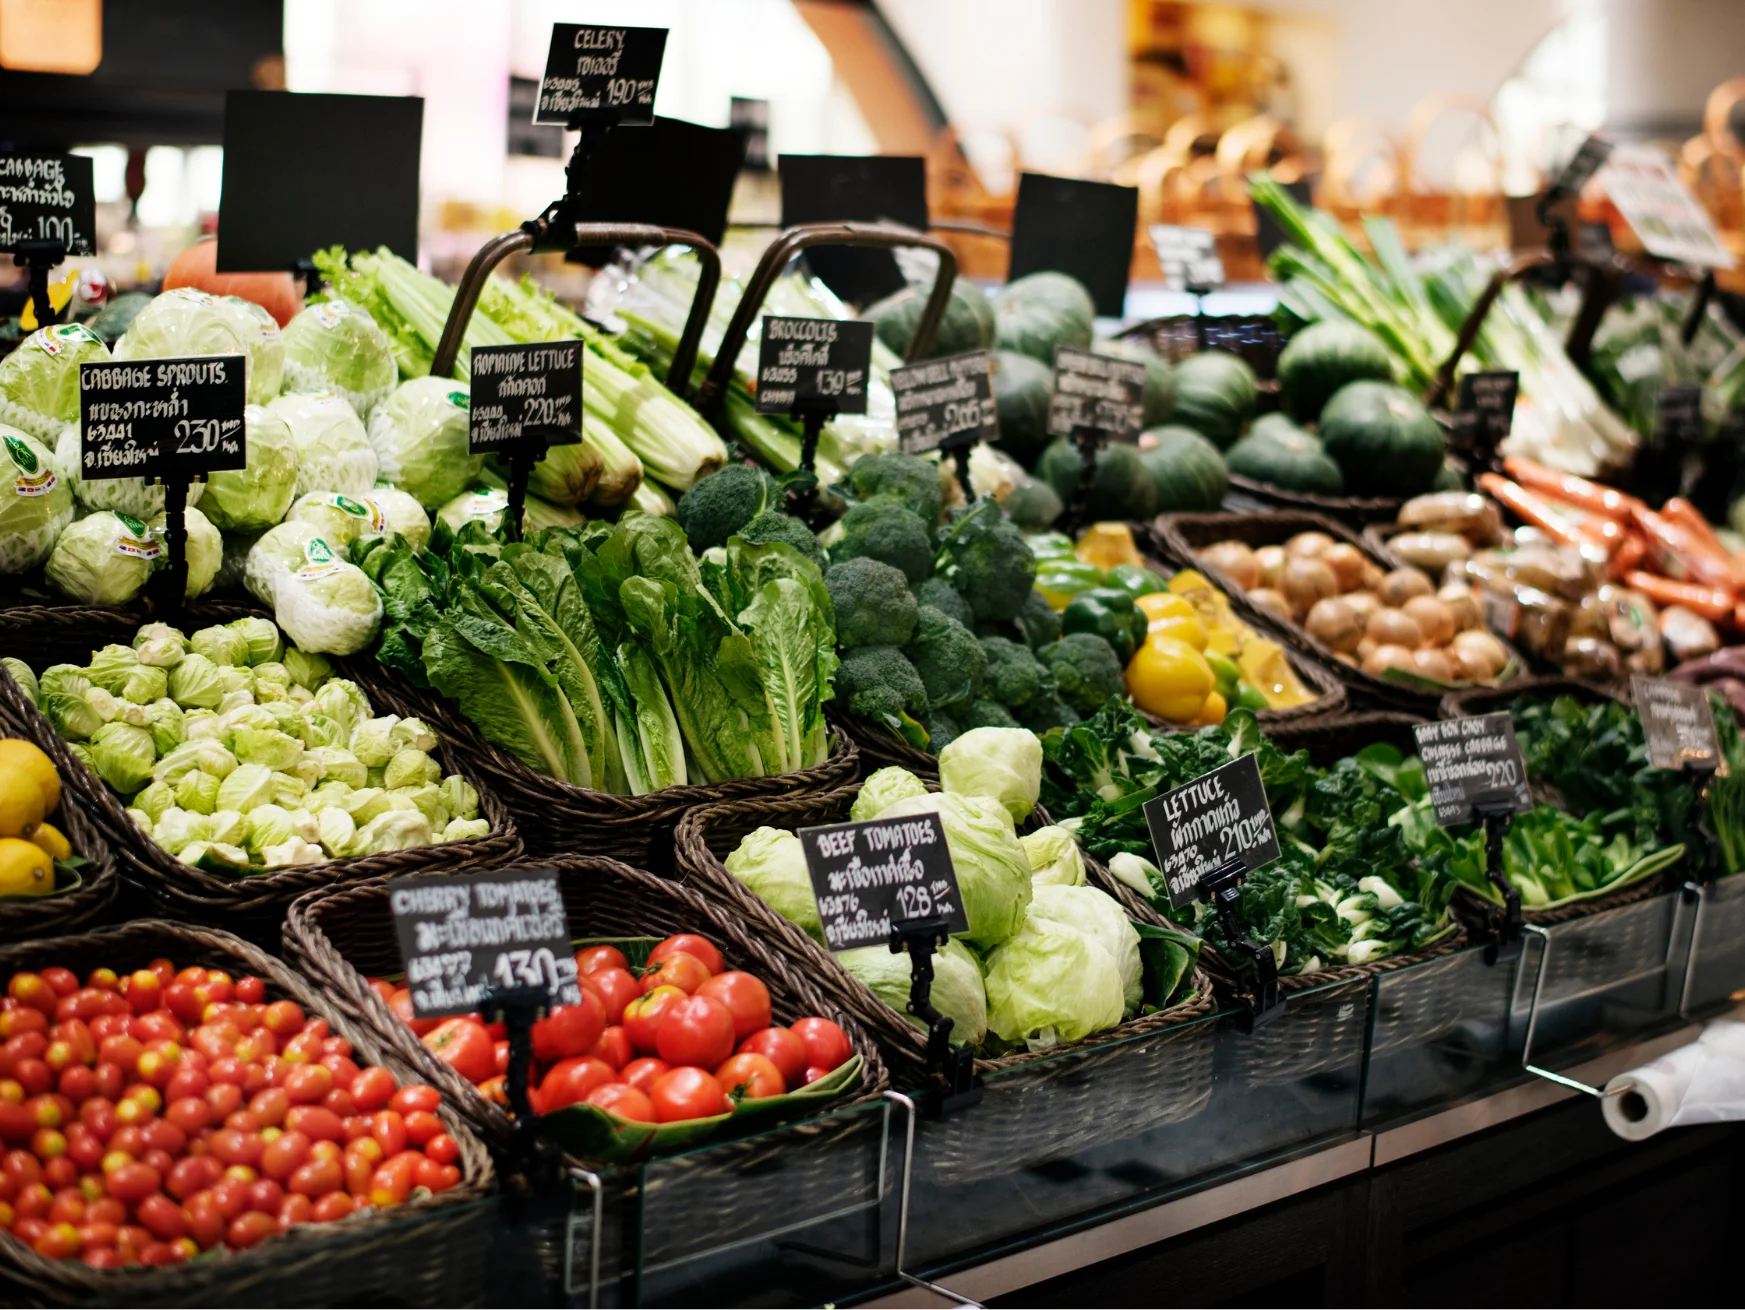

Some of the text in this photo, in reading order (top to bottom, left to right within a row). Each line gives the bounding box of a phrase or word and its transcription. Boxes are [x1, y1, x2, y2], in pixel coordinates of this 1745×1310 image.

[574, 29, 626, 49] CELERY
[606, 78, 637, 105] 190
[527, 348, 575, 372] LETTUCE
[81, 365, 152, 391] CABBAGE
[816, 370, 845, 395] 139
[87, 422, 132, 442] 63441
[173, 418, 221, 454] 230
[1486, 759, 1517, 789] 220
[1163, 775, 1225, 822] LETTUCE
[816, 829, 856, 859] BEEF
[390, 884, 471, 917] CHERRY
[896, 885, 932, 919] 128
